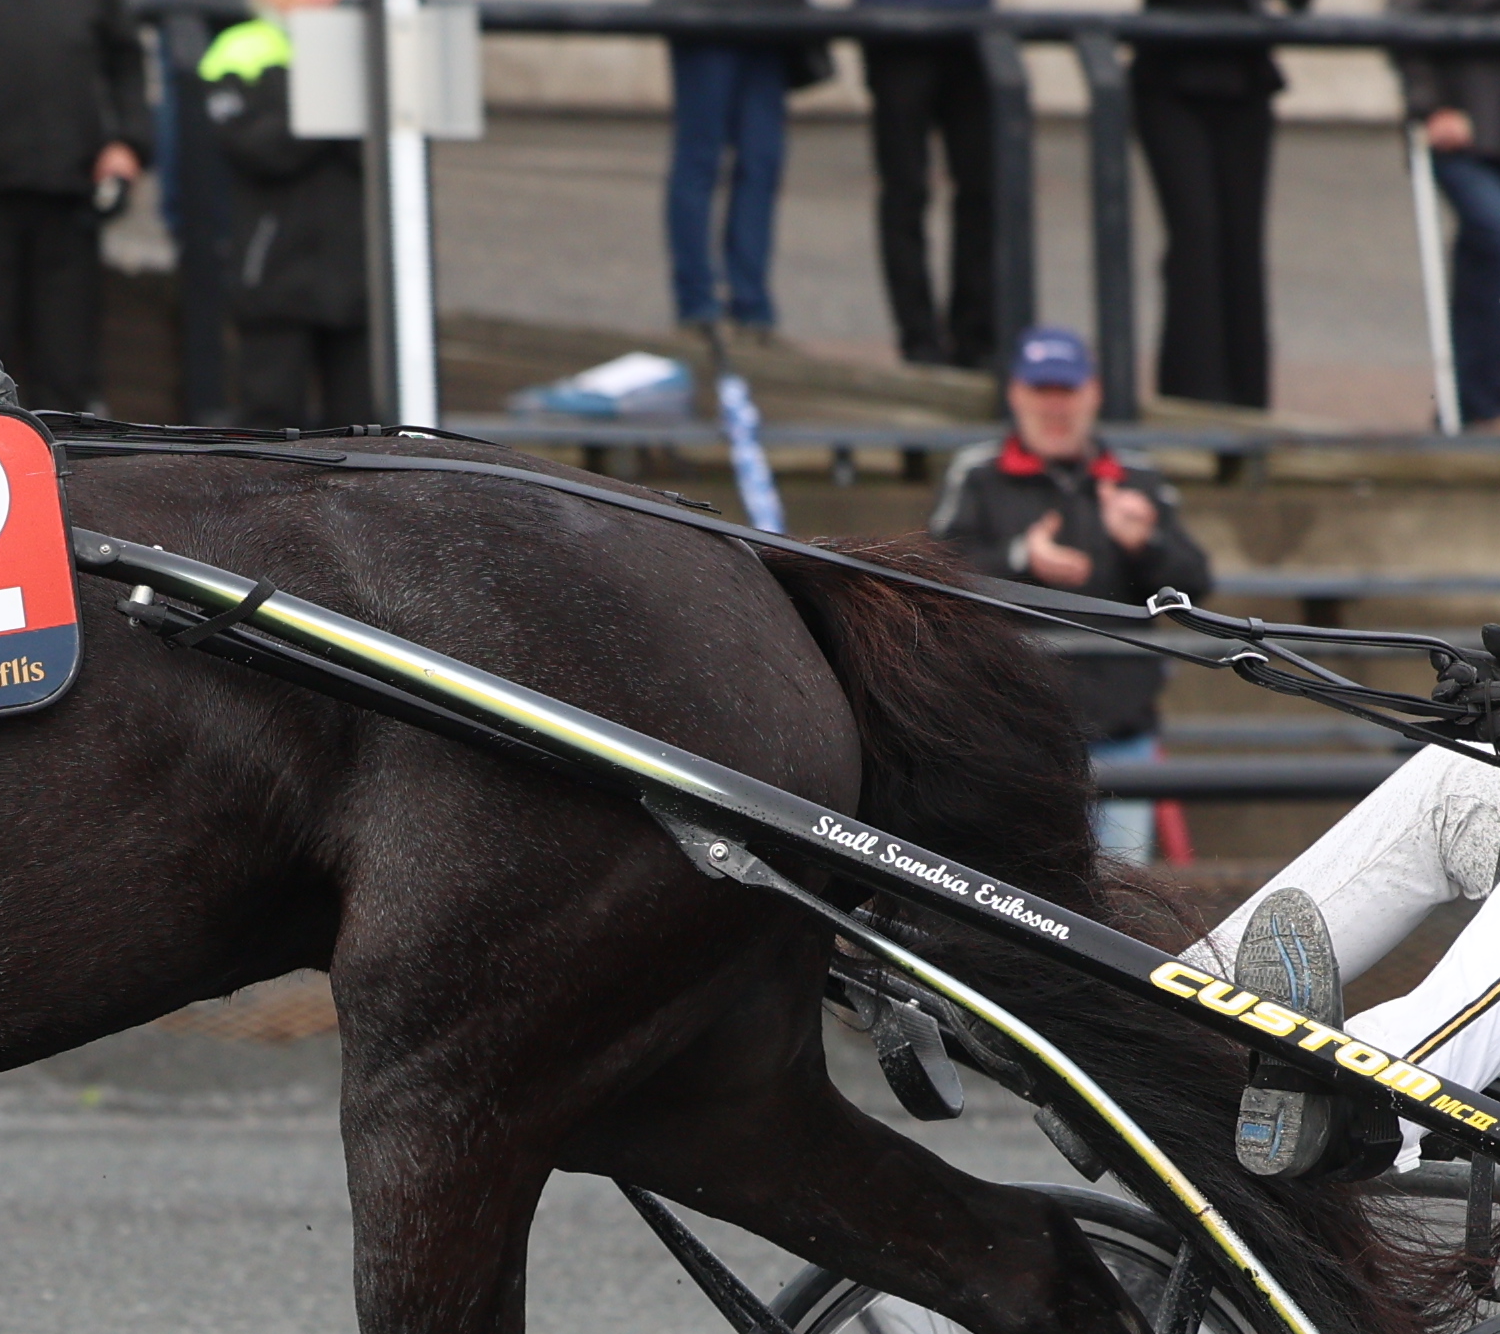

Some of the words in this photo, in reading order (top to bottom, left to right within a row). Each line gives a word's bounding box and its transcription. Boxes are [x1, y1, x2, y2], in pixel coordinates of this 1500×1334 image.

[812, 815, 879, 856] Stall
[879, 843, 969, 896] Sandra
[974, 883, 1070, 941] Eriksson
[1149, 961, 1443, 1102] CUSTOM
